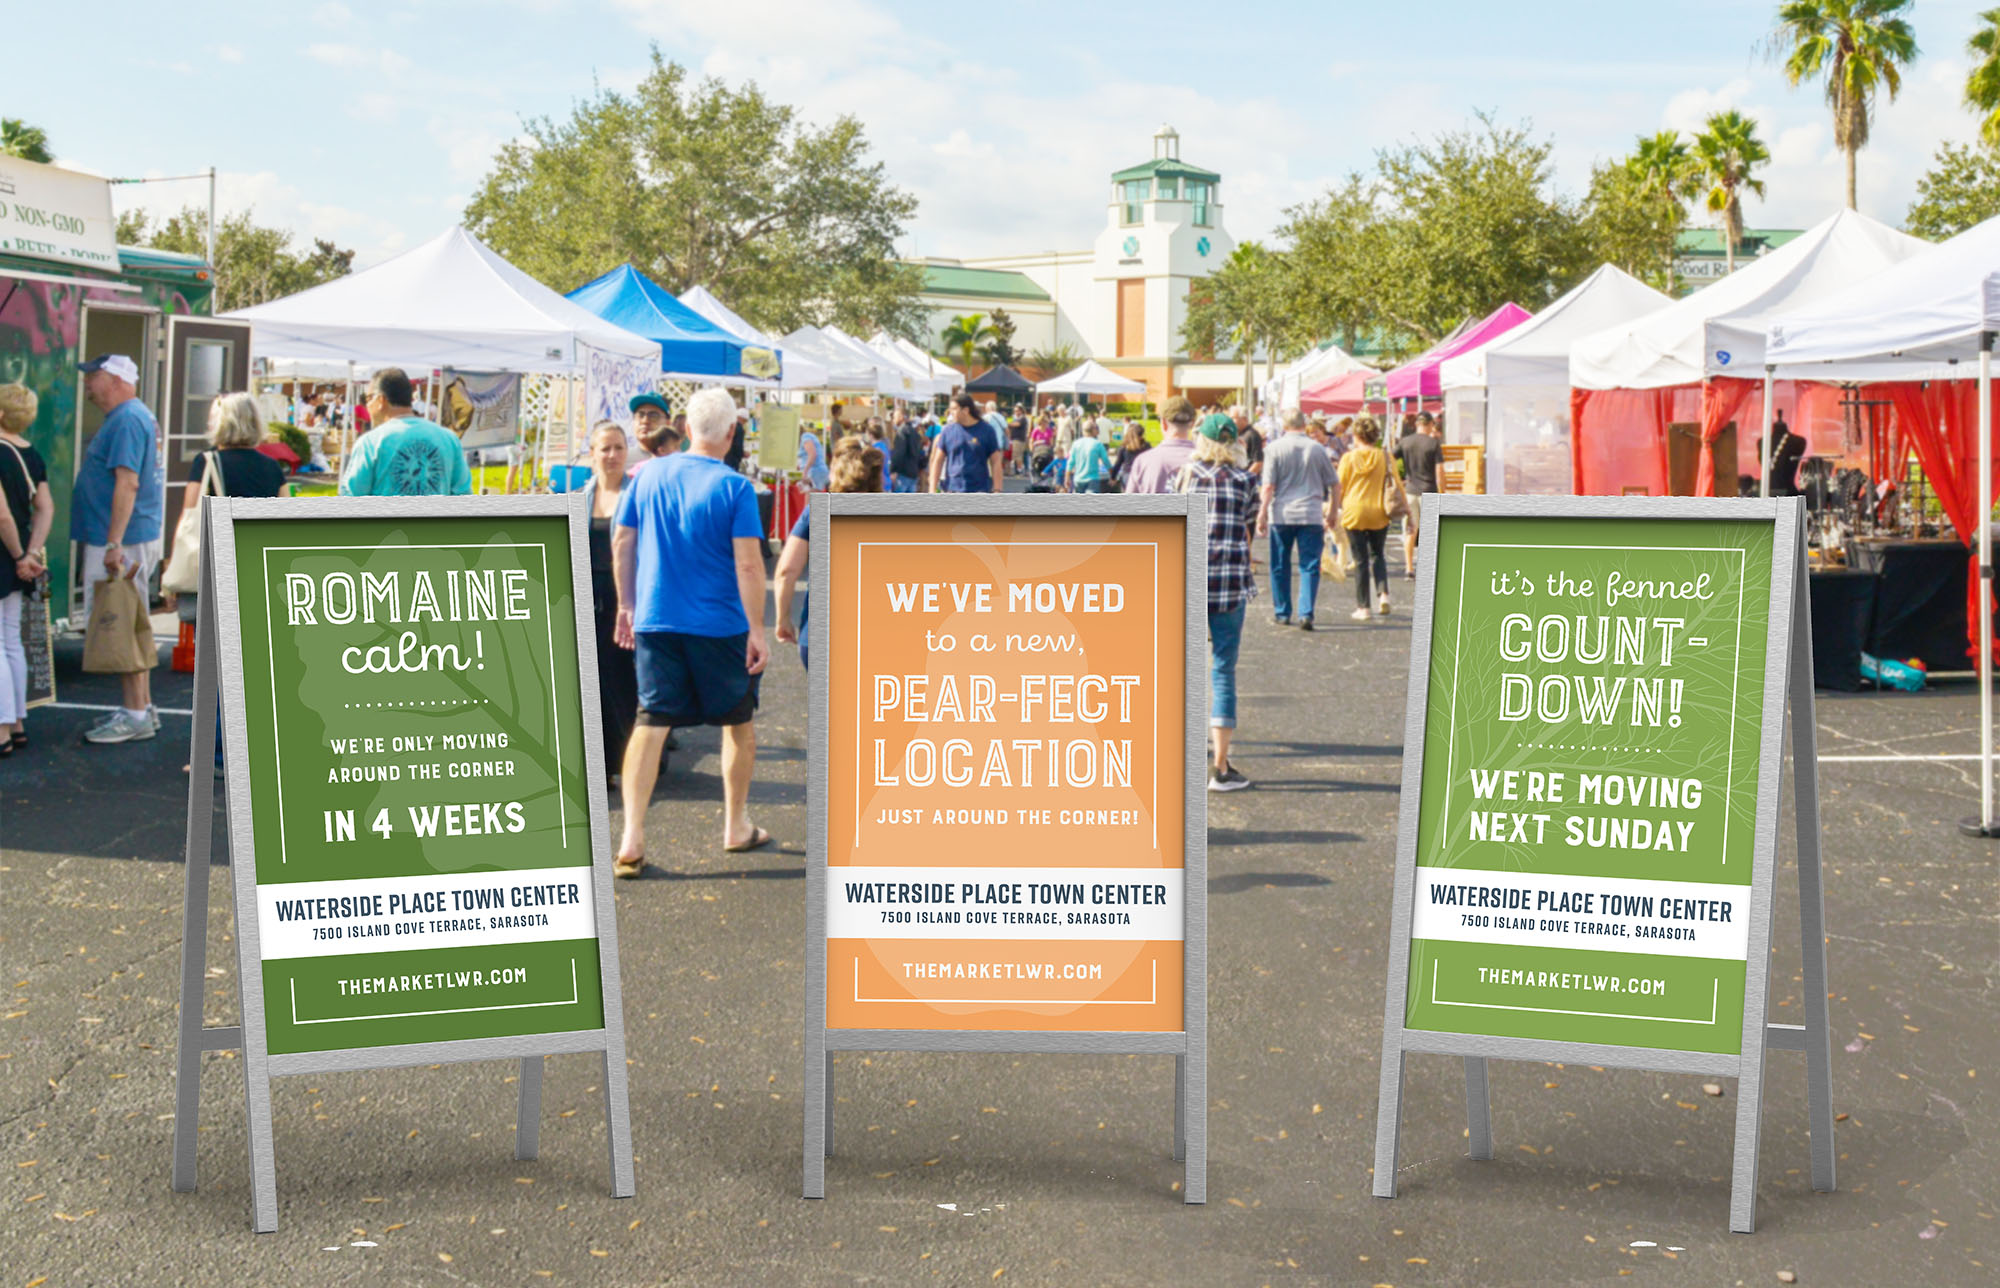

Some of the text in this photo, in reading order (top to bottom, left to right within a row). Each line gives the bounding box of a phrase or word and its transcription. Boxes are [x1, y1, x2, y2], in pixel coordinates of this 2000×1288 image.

[14, 204, 85, 236] NON-GMO
[285, 570, 530, 625] ROMAINE
[886, 583, 1124, 613] WE'VE MOVED
[1492, 570, 1713, 606] it's the fennel
[342, 631, 483, 673] calm!
[926, 630, 1083, 656] to a new,
[1500, 614, 1707, 666] COUNT-
[874, 675, 1140, 723] PEAR-FECT
[1499, 673, 1684, 728] DOWN!
[331, 733, 507, 754] WE'RE ONLY MOVING
[329, 761, 514, 783] AROUND THE CORNER
[875, 739, 1131, 788] LOCATION
[1470, 769, 1702, 809] WE'RE MOVING
[324, 802, 525, 842] IN 4 WEEKS
[877, 809, 1138, 824] JUST AROUND THE CORNER!
[1470, 811, 1694, 851] NEXT SUNDAY
[276, 884, 579, 921] WATERSIDE PLACE TOWN CENTER
[846, 883, 1166, 904] WATERSIDE PLACE TOWN CENTER
[1431, 884, 1731, 922] WATERSIDE PLACE TOWN CENTER
[313, 914, 548, 940] 7500 ISLAND COVE TERRACE, SARASOTA
[881, 912, 1130, 925] 7500 ISLAND COVE TERRACE, SARASOTA
[1462, 915, 1695, 940] 7500 ISLAND COVE TERRACE, SARASOTA
[338, 968, 526, 995] THEMARKETLWR.COM
[903, 963, 1101, 979] THEMARKETLWR.COM
[1479, 968, 1664, 995] THEMARKETLWR.COM
